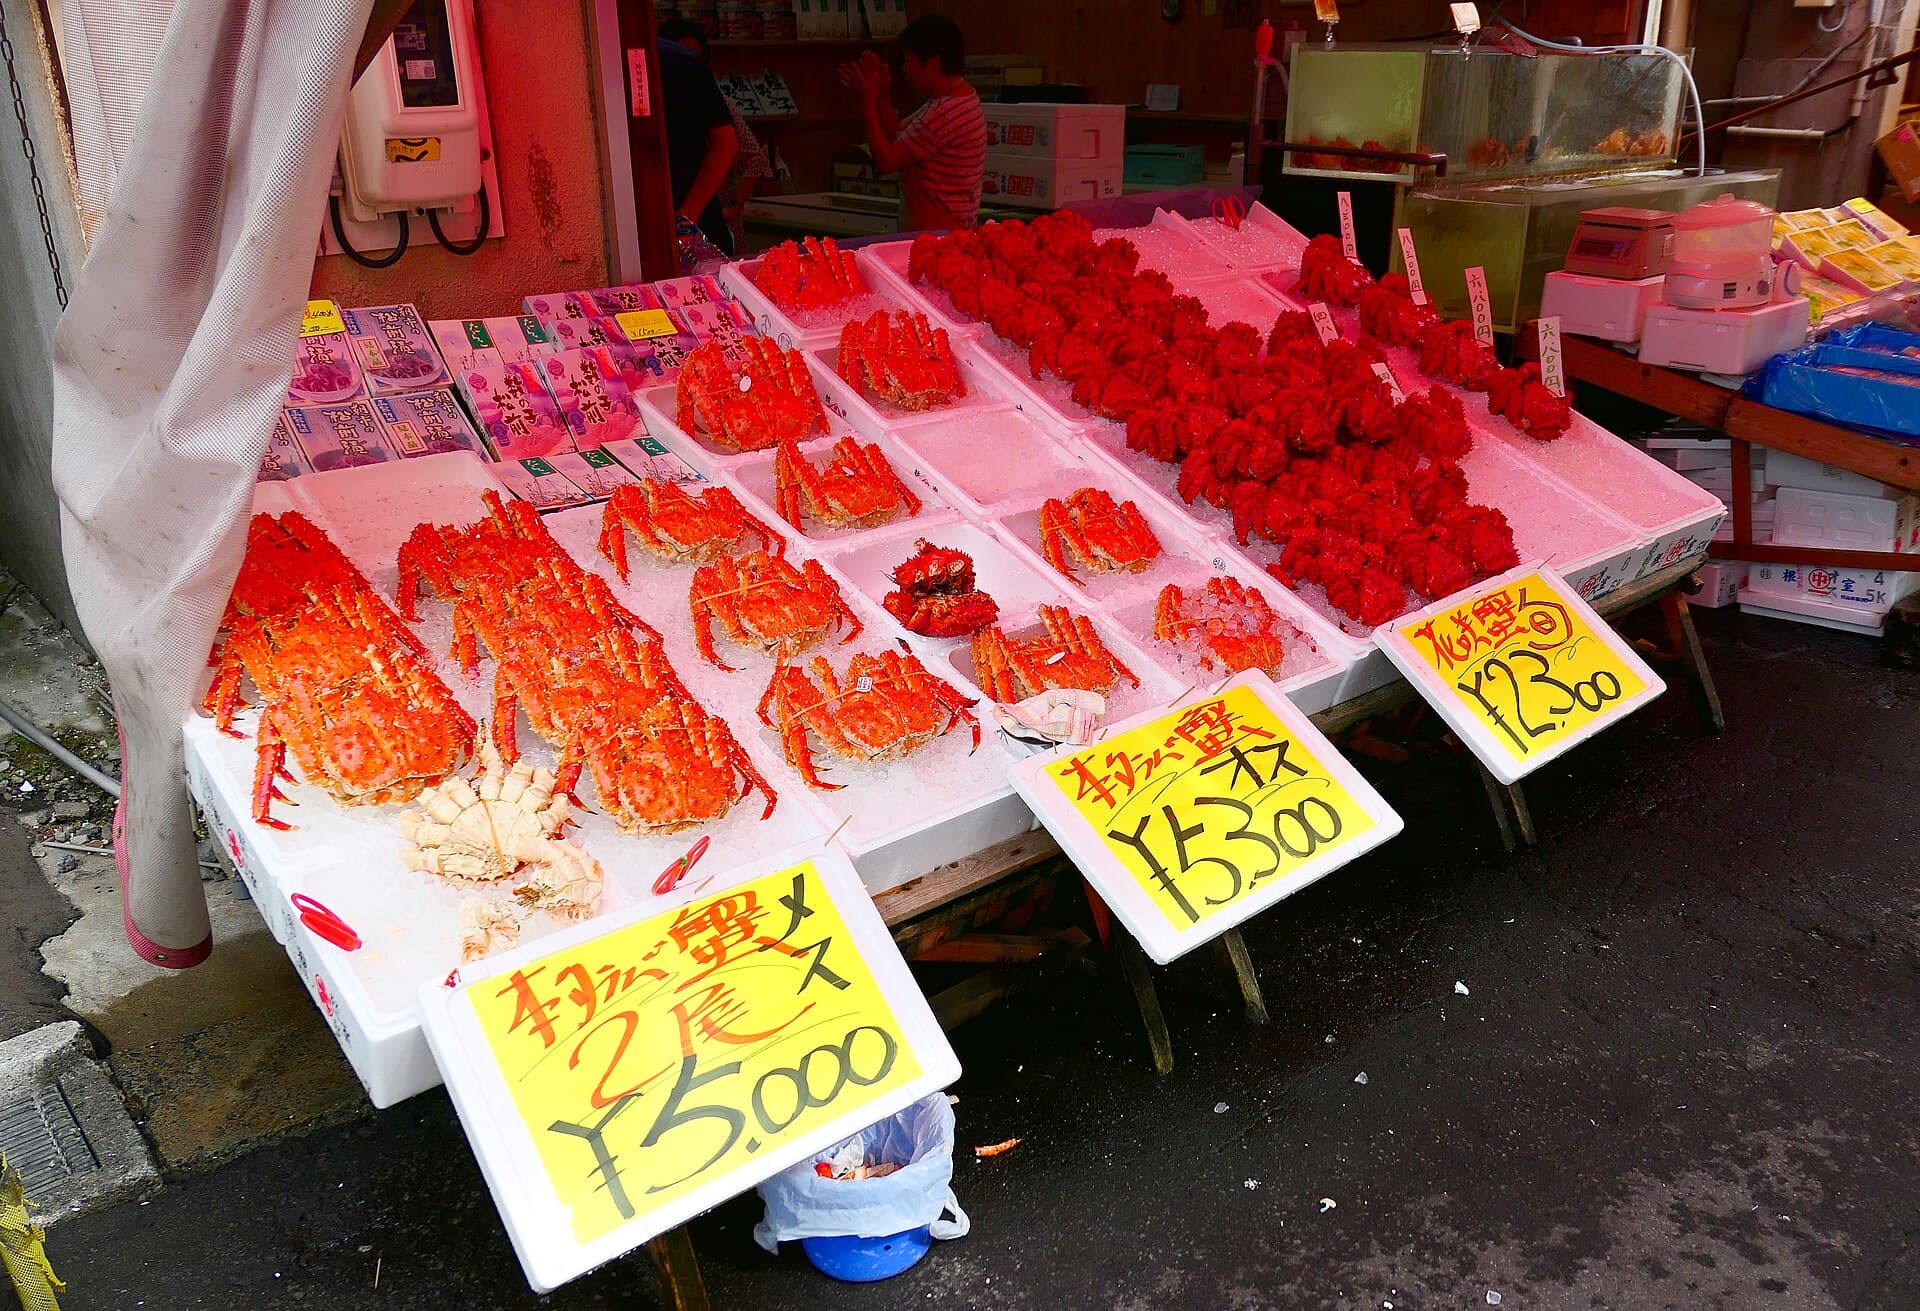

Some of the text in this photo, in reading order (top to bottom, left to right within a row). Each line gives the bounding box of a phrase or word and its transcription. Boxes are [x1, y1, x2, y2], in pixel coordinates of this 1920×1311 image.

[1200, 740, 1308, 790] オス
[758, 873, 852, 995] メス
[569, 981, 817, 1110] 2尾
